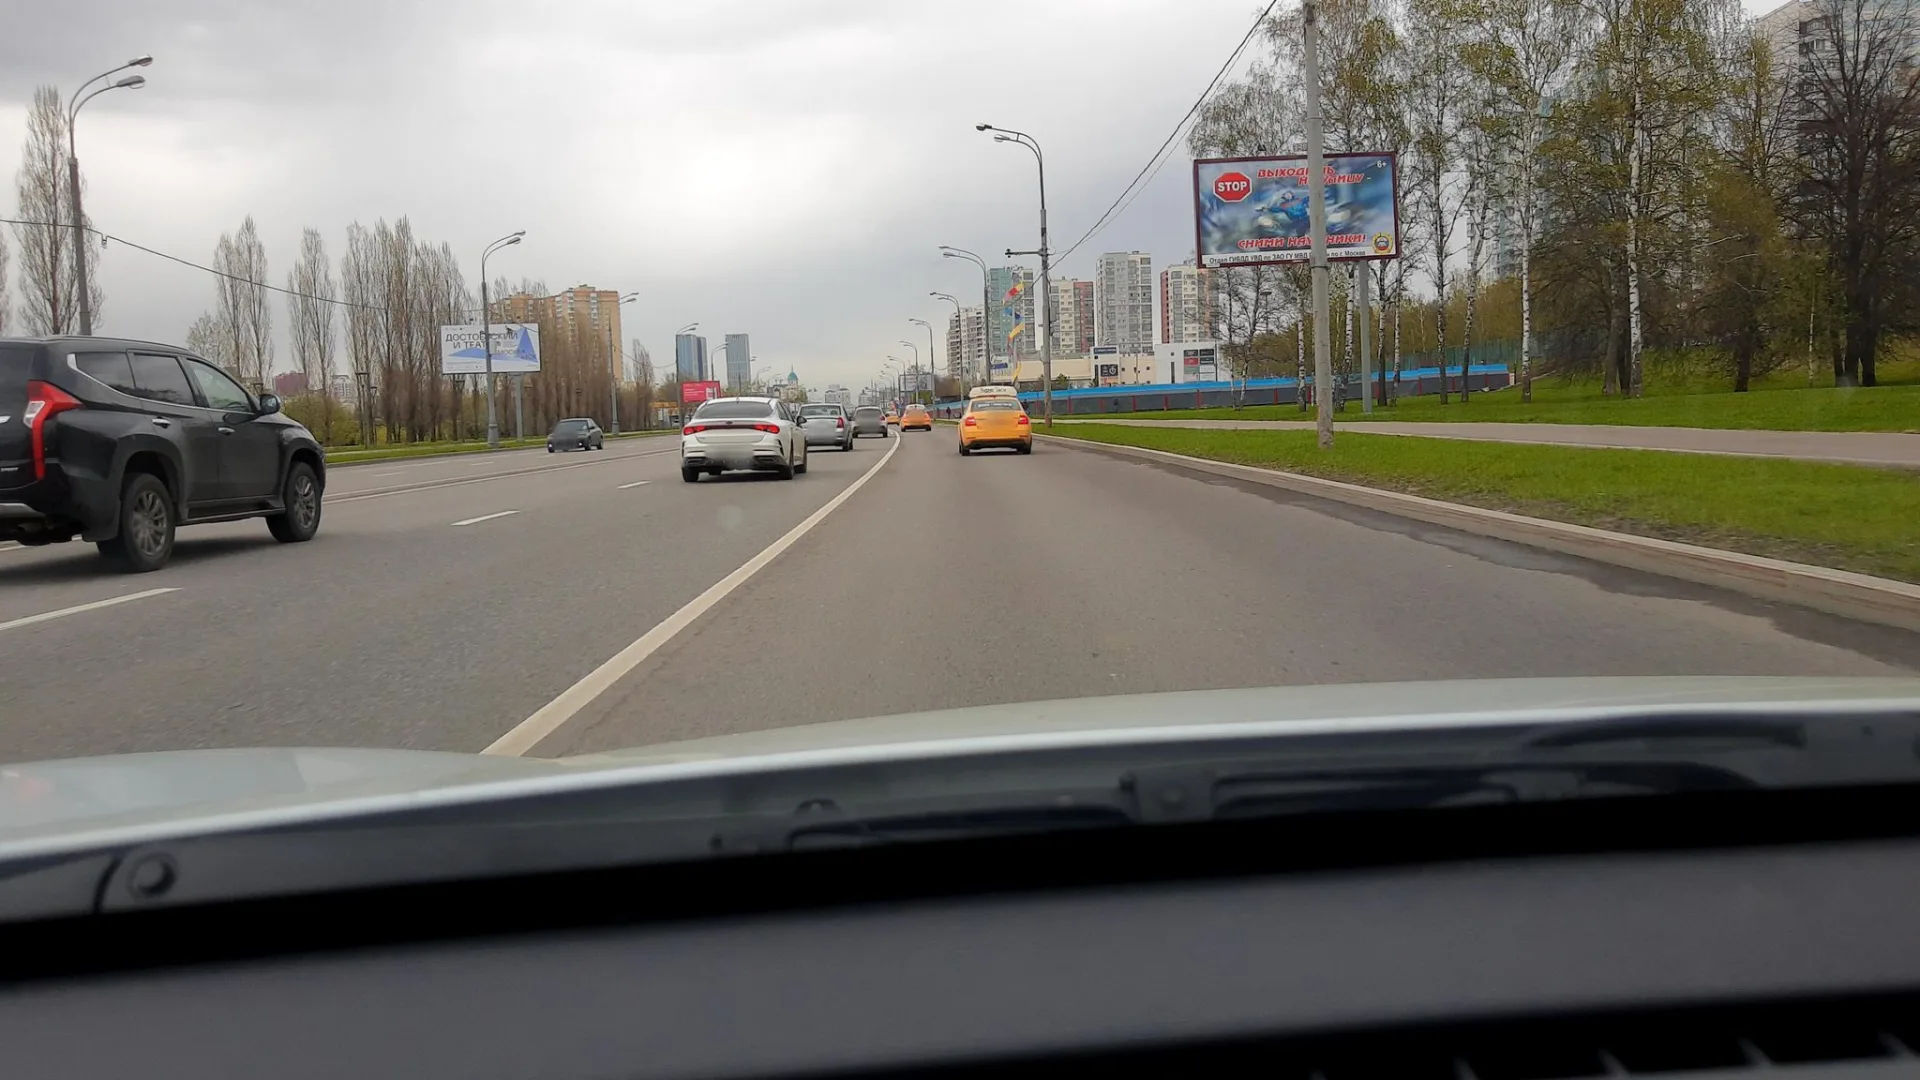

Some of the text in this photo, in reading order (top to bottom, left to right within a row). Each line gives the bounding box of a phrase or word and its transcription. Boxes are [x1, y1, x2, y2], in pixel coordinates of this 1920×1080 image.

[1376, 160, 1387, 168] 6+
[1257, 166, 1335, 178] ВЫХОДЬ
[1217, 181, 1248, 192] STOP
[1237, 236, 1285, 248] СНИМИ
